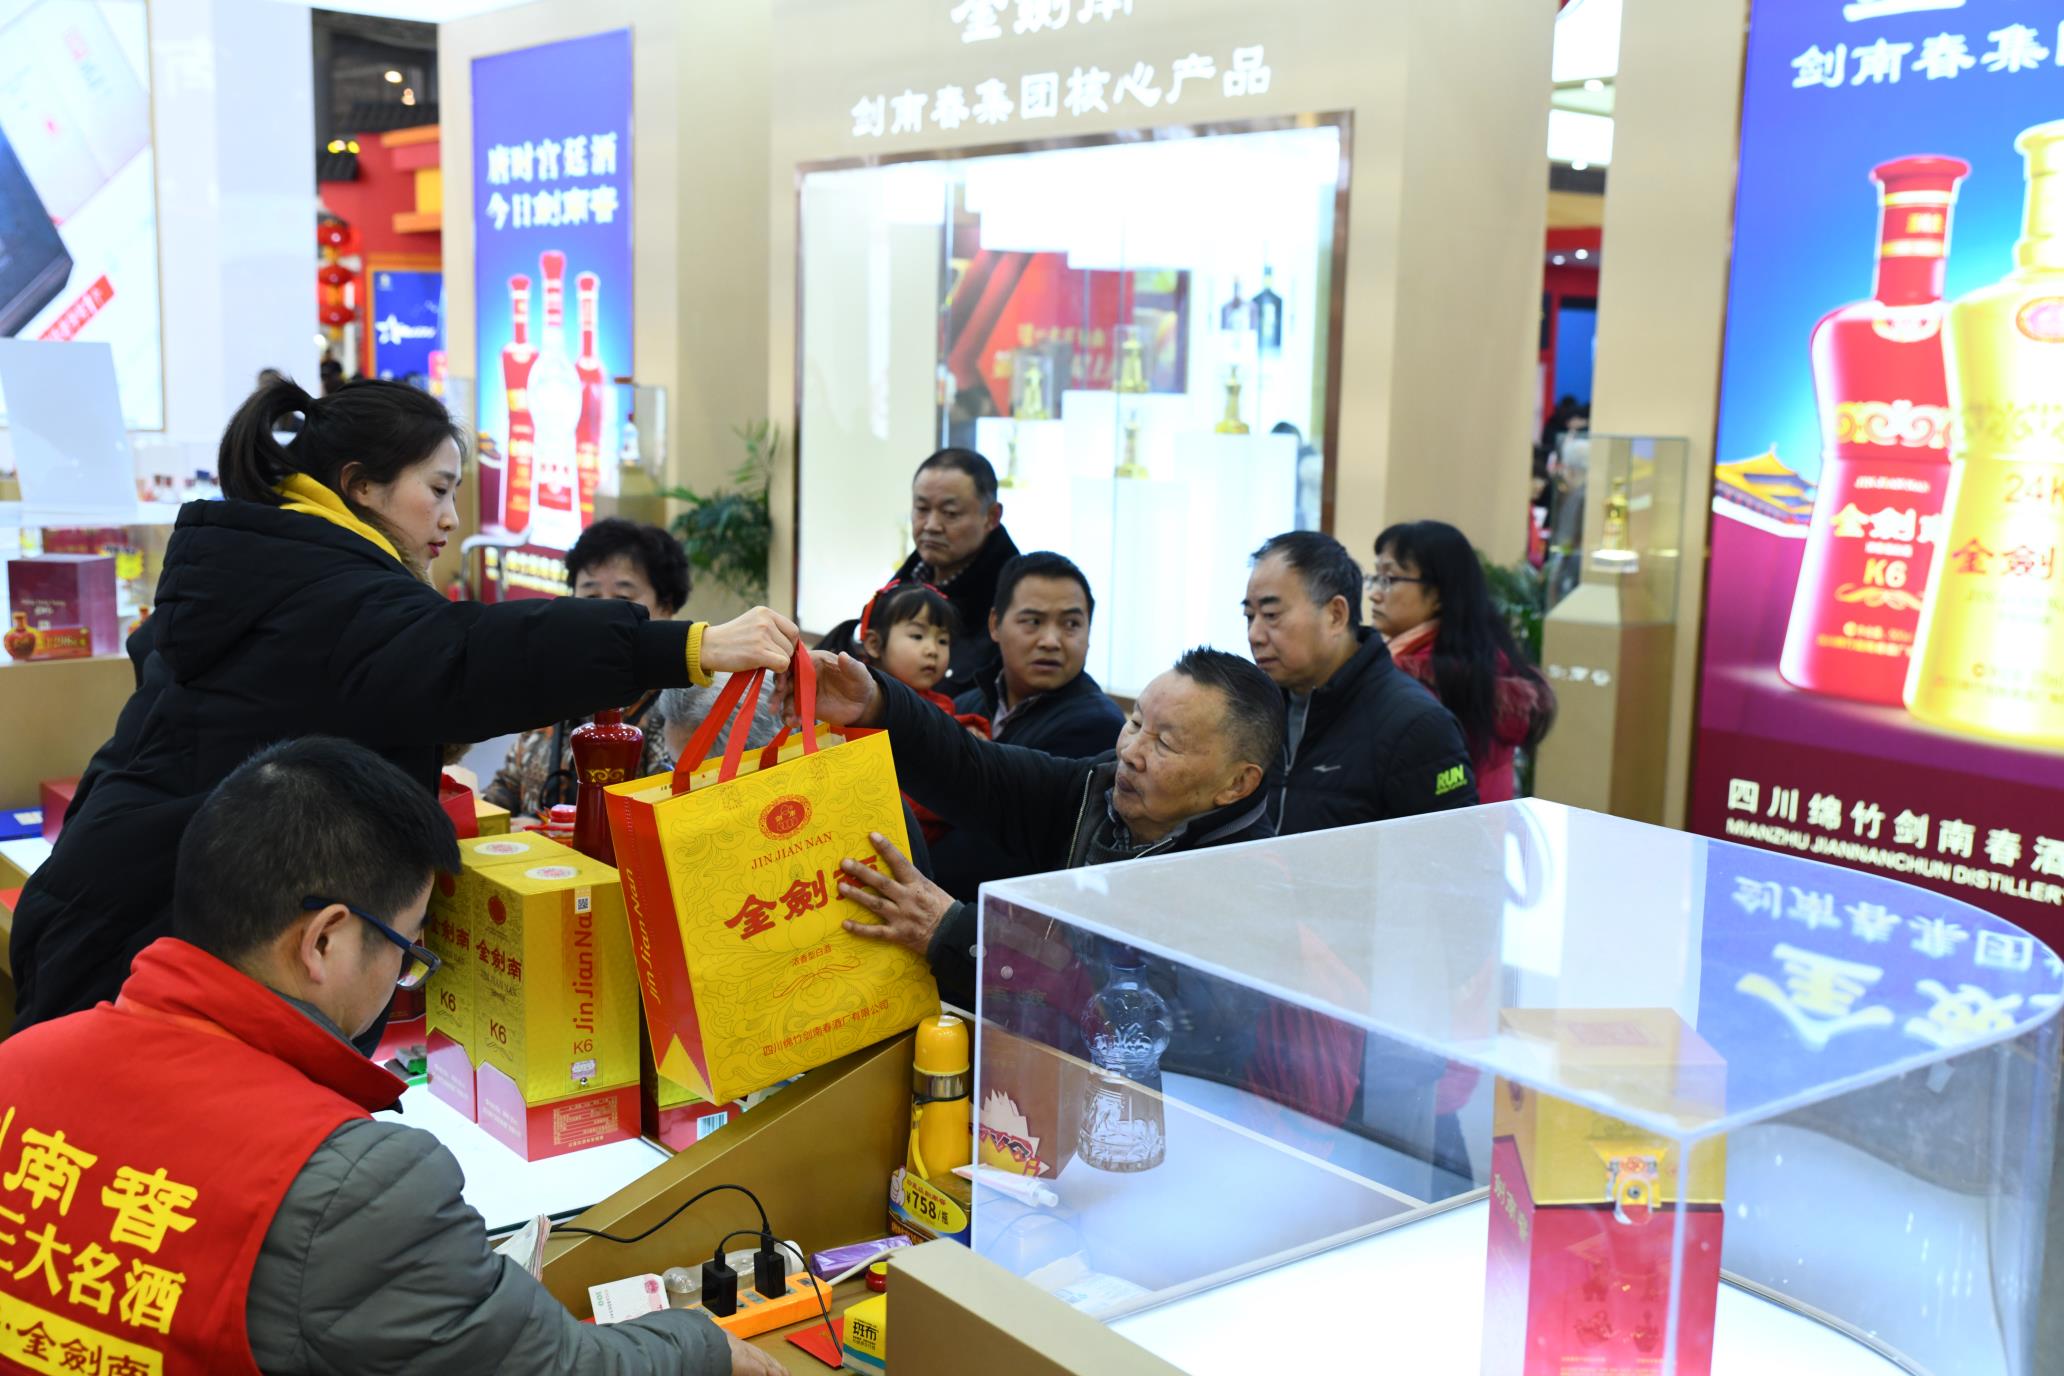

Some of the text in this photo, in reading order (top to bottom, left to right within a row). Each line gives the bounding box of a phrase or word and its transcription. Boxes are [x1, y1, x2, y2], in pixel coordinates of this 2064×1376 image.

[1790, 20, 2064, 89] 剑南春集
[850, 45, 1271, 137] 剑南春集团核心产品
[1863, 557, 1909, 588] K6
[1437, 764, 1464, 790] RUN
[751, 831, 833, 870] JIN JIAN NAN
[1725, 817, 2064, 907] MIANZHU JIANNANCHUN DISTILLER
[626, 868, 661, 1005] Jin Jian Nan
[573, 911, 594, 1034] Jin Jian Na
[791, 943, 833, 967] 浓香型白酒
[440, 987, 457, 1012] K6
[490, 1019, 508, 1045] K6
[763, 1000, 889, 1057] 四川绵竹剑南春酒厂有限公司
[573, 1038, 594, 1055] K6
[853, 1320, 879, 1342] 斑布
